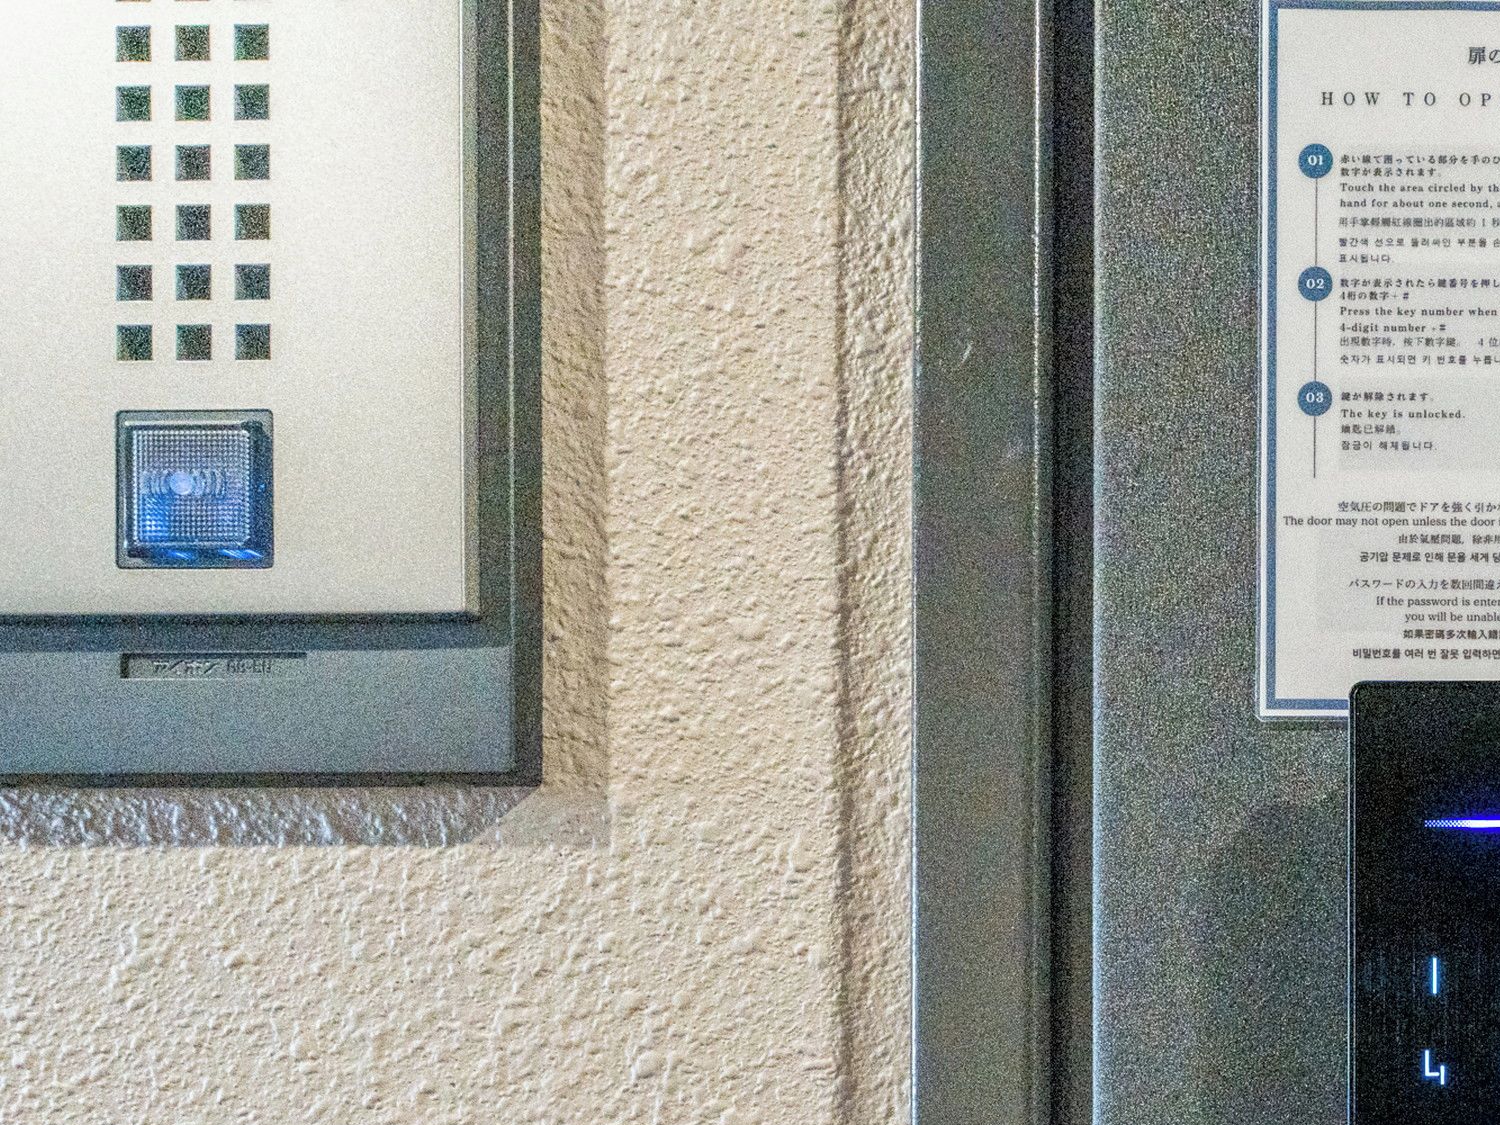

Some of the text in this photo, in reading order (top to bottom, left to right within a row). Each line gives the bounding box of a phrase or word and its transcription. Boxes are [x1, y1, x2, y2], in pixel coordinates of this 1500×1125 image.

[1320, 91, 1380, 106] HOW
[1402, 91, 1437, 107] TO
[1307, 154, 1325, 165] 01
[1340, 183, 1374, 192] Touch
[1379, 184, 1395, 192] the
[1428, 184, 1465, 192] circled
[1470, 184, 1483, 194] by
[1340, 199, 1366, 207] hand
[1372, 199, 1388, 207] for
[1393, 199, 1423, 207] about
[1452, 200, 1492, 209] second,
[1306, 279, 1325, 290] 02
[1340, 306, 1370, 315] Press
[1375, 307, 1392, 315] the
[1397, 307, 1416, 317] key
[1421, 307, 1464, 316] number
[1468, 307, 1497, 316] when
[1340, 323, 1426, 333] 4-digit number
[1306, 392, 1324, 403] 03
[1341, 409, 1465, 419] The key is unlocked.
[1283, 515, 1304, 526] The
[1306, 515, 1333, 526] door
[1335, 518, 1358, 527] may
[1361, 518, 1378, 526] not
[1382, 518, 1409, 527] open
[1413, 517, 1447, 526] unless
[1450, 517, 1467, 526] the
[1470, 517, 1495, 526] door
[1359, 551, 1389, 563] 공기압
[1392, 552, 1421, 563] 문제로
[1424, 552, 1444, 562] 인해
[1447, 552, 1466, 563] 문을
[1470, 552, 1489, 562] 세게
[1376, 596, 1385, 606] If
[1386, 596, 1404, 606] the
[1407, 597, 1458, 607] password
[1462, 598, 1470, 606] is
[1405, 614, 1424, 623] you
[1428, 612, 1446, 621] will
[1450, 612, 1463, 621] be
[1352, 648, 1401, 660] 비밀번호를
[1404, 649, 1423, 659] 여러
[1427, 649, 1436, 659] 번
[1440, 649, 1459, 659] 잘못
[1462, 649, 1500, 659] 입력하면
[1429, 957, 1441, 995] 1
[1423, 1048, 1448, 1087] 4
